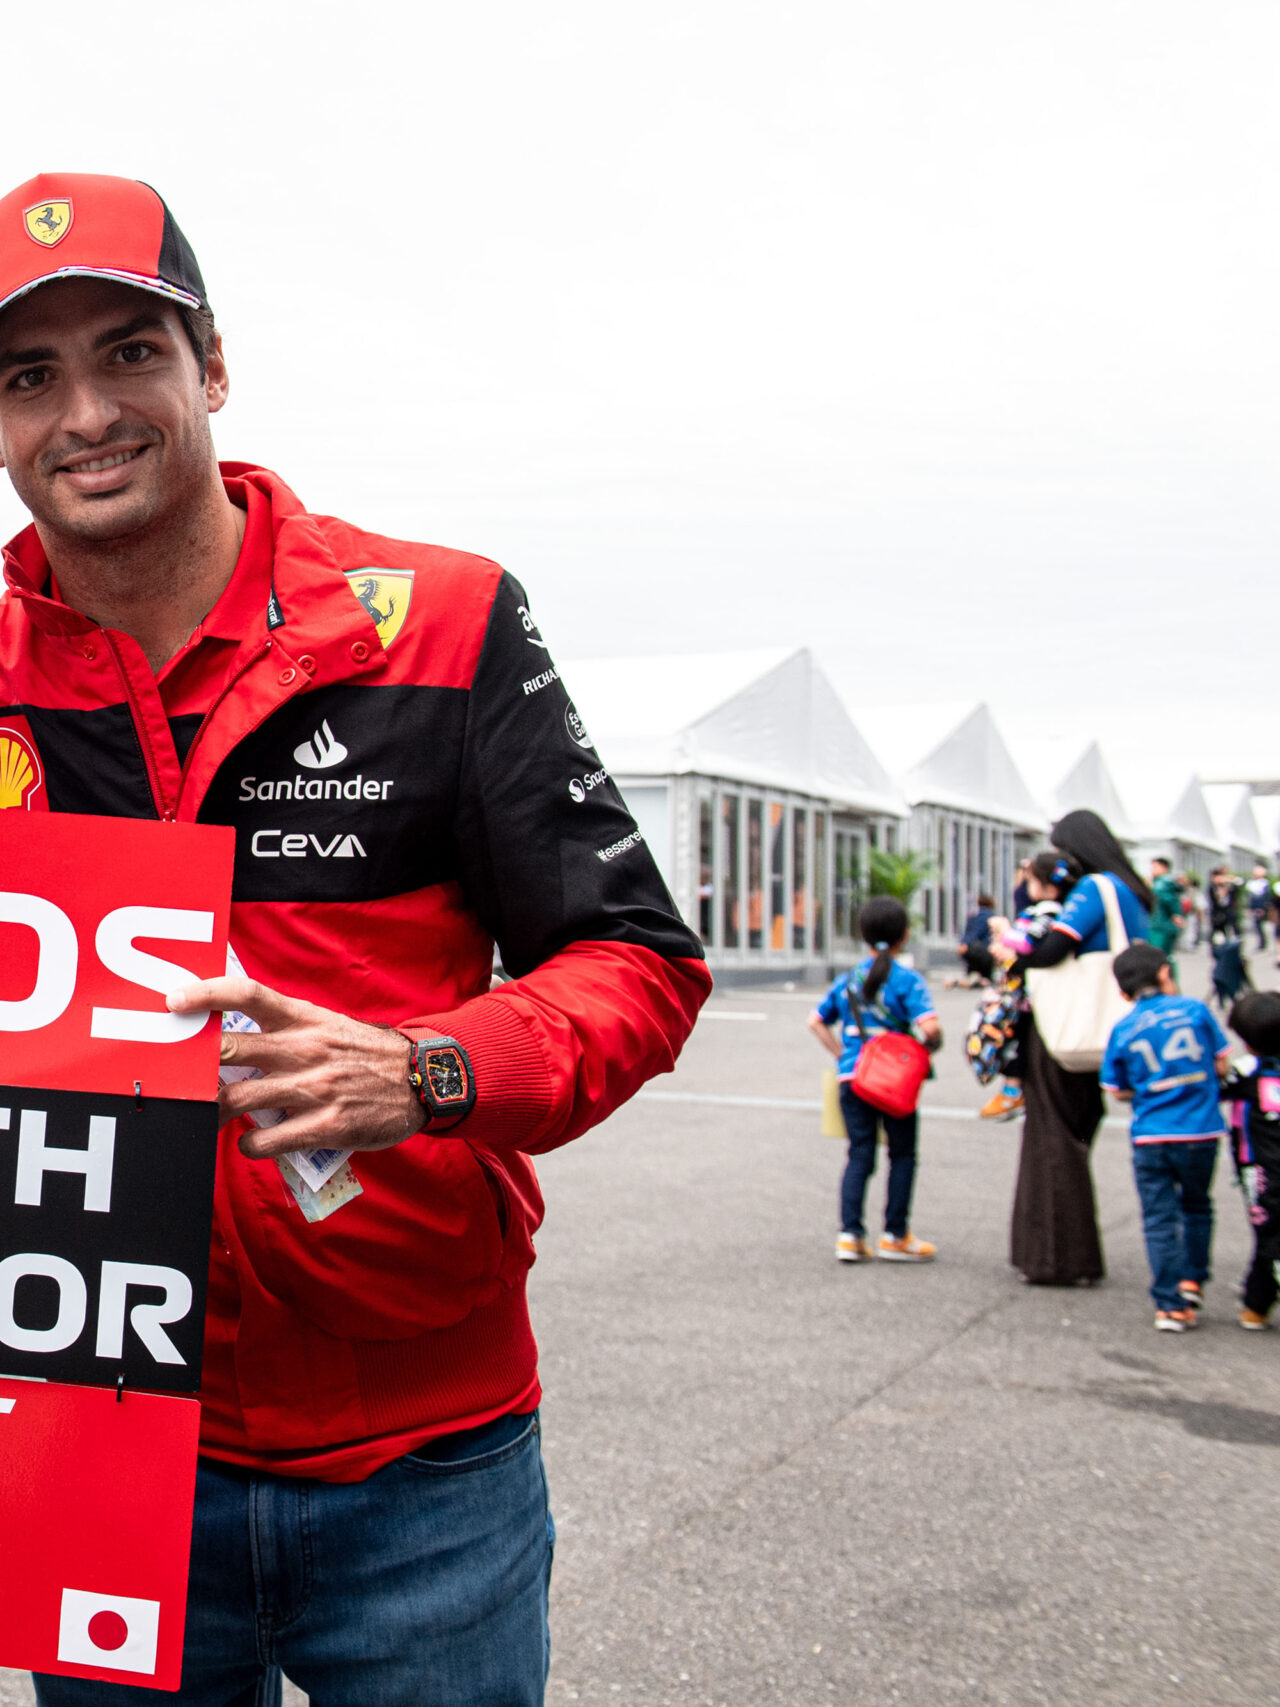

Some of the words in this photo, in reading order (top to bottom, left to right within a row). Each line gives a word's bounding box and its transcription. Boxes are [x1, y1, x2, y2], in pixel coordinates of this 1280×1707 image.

[522, 668, 560, 695] RICHA
[238, 774, 394, 801] Santander
[583, 767, 608, 790] Snap
[597, 831, 643, 861] #essere
[1128, 1026, 1205, 1073] 14
